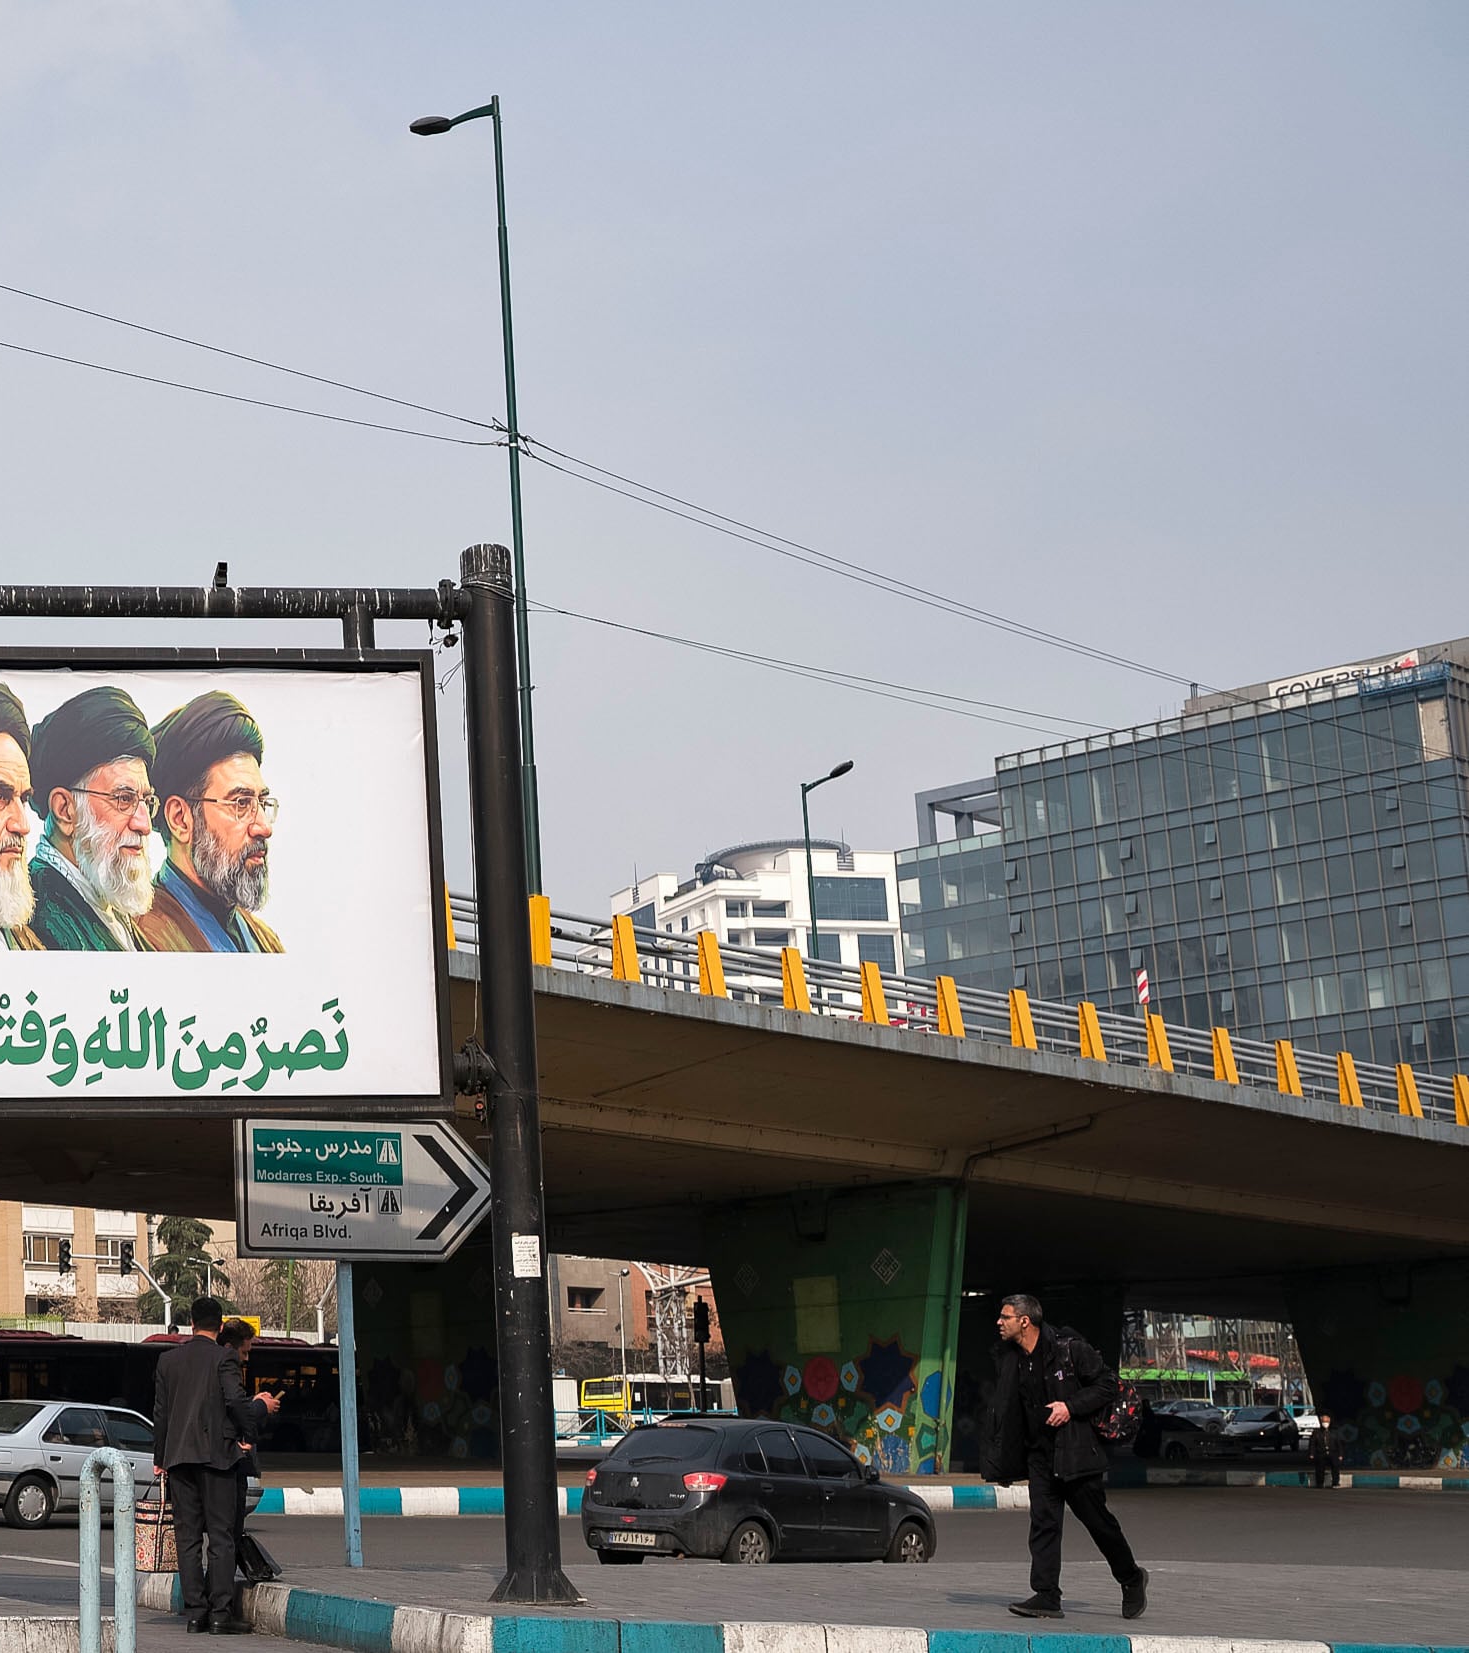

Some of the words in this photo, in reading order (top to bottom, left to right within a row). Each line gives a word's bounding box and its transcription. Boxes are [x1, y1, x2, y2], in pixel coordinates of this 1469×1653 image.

[256, 1138, 303, 1160] جنوب
[315, 1139, 372, 1161] مدرس
[256, 1169, 313, 1183] Modarres
[349, 1172, 388, 1184] South.
[309, 1187, 372, 1220] آفریقا
[260, 1222, 308, 1240] Afriqa
[313, 1224, 352, 1239] Blvd.
